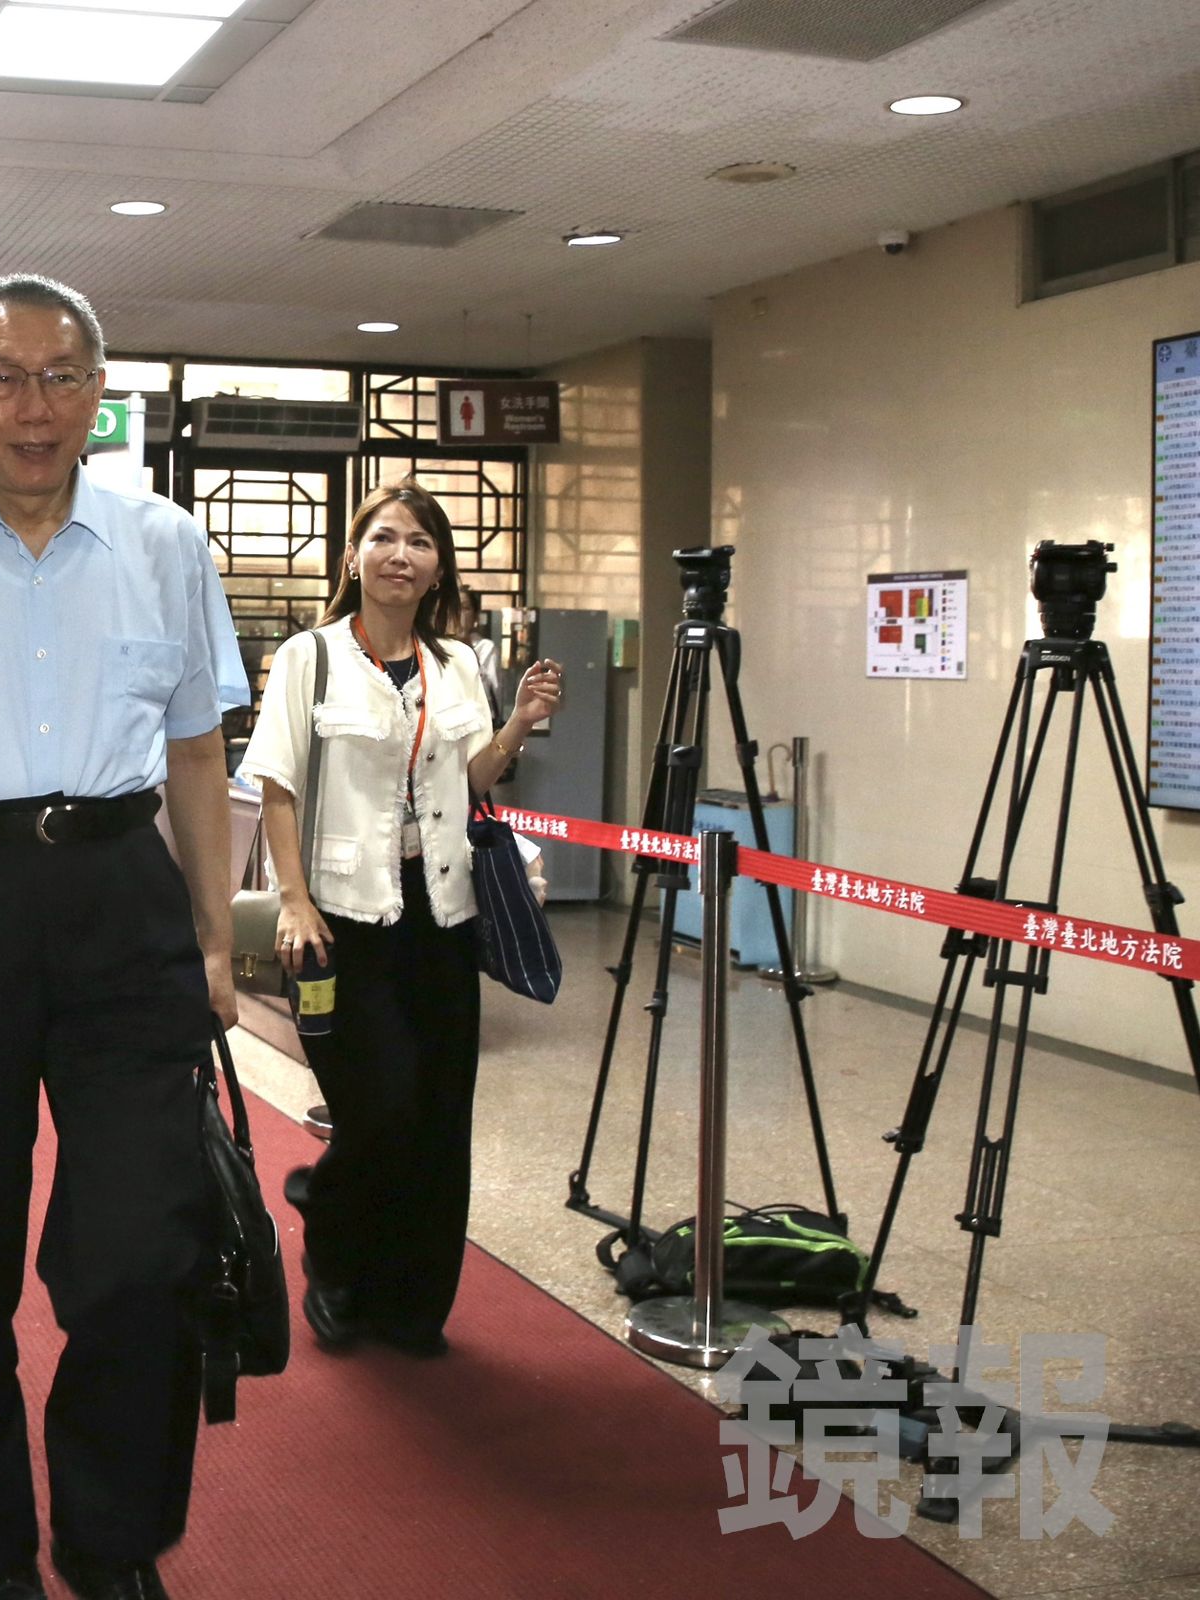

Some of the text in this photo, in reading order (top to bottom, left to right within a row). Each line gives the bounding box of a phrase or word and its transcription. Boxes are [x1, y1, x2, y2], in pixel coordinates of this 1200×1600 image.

[811, 869, 925, 914] 臺灣臺北地方法院
[1022, 912, 1184, 970] 臺灣臺北地方法院
